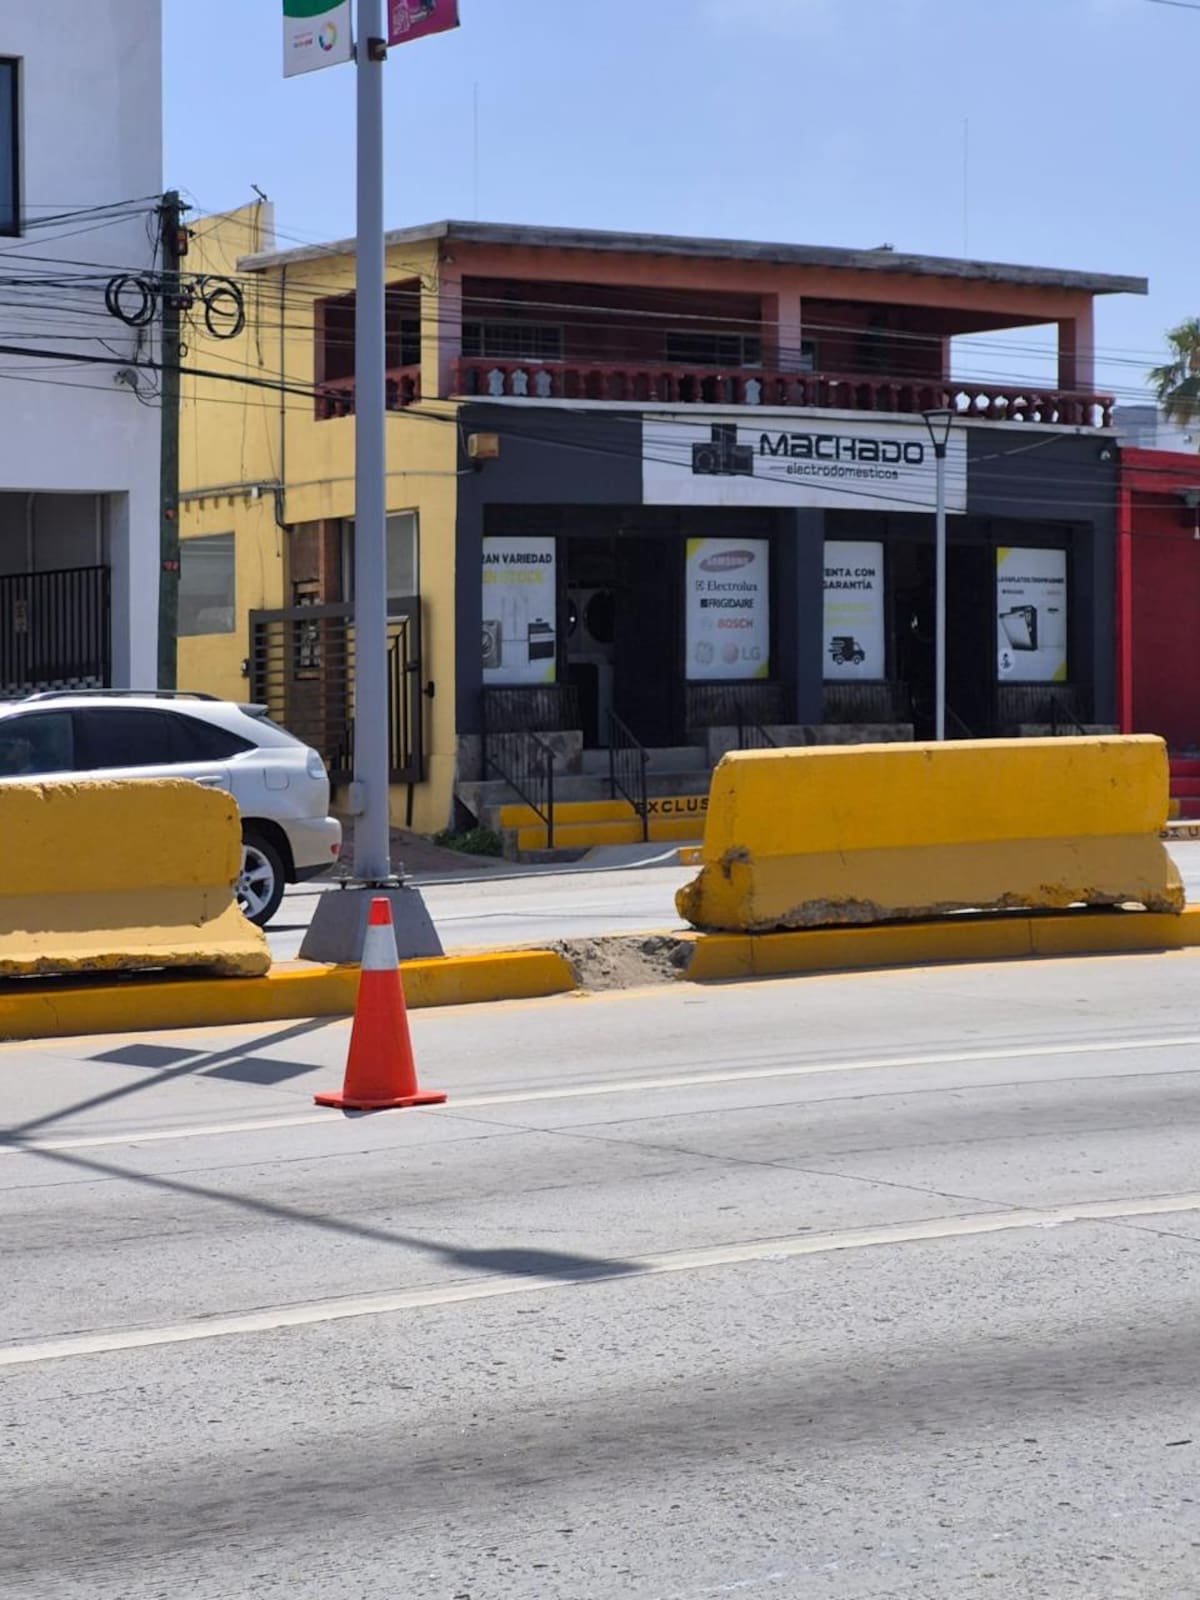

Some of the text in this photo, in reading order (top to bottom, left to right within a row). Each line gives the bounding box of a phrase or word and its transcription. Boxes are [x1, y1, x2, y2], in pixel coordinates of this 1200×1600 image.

[502, 553, 552, 563] VARIEDAD
[855, 568, 875, 576] CON
[707, 580, 758, 591] Electrolux
[708, 598, 754, 608] FRIGIDAIRE
[717, 618, 753, 629] BOSCH
[742, 646, 761, 661] LG
